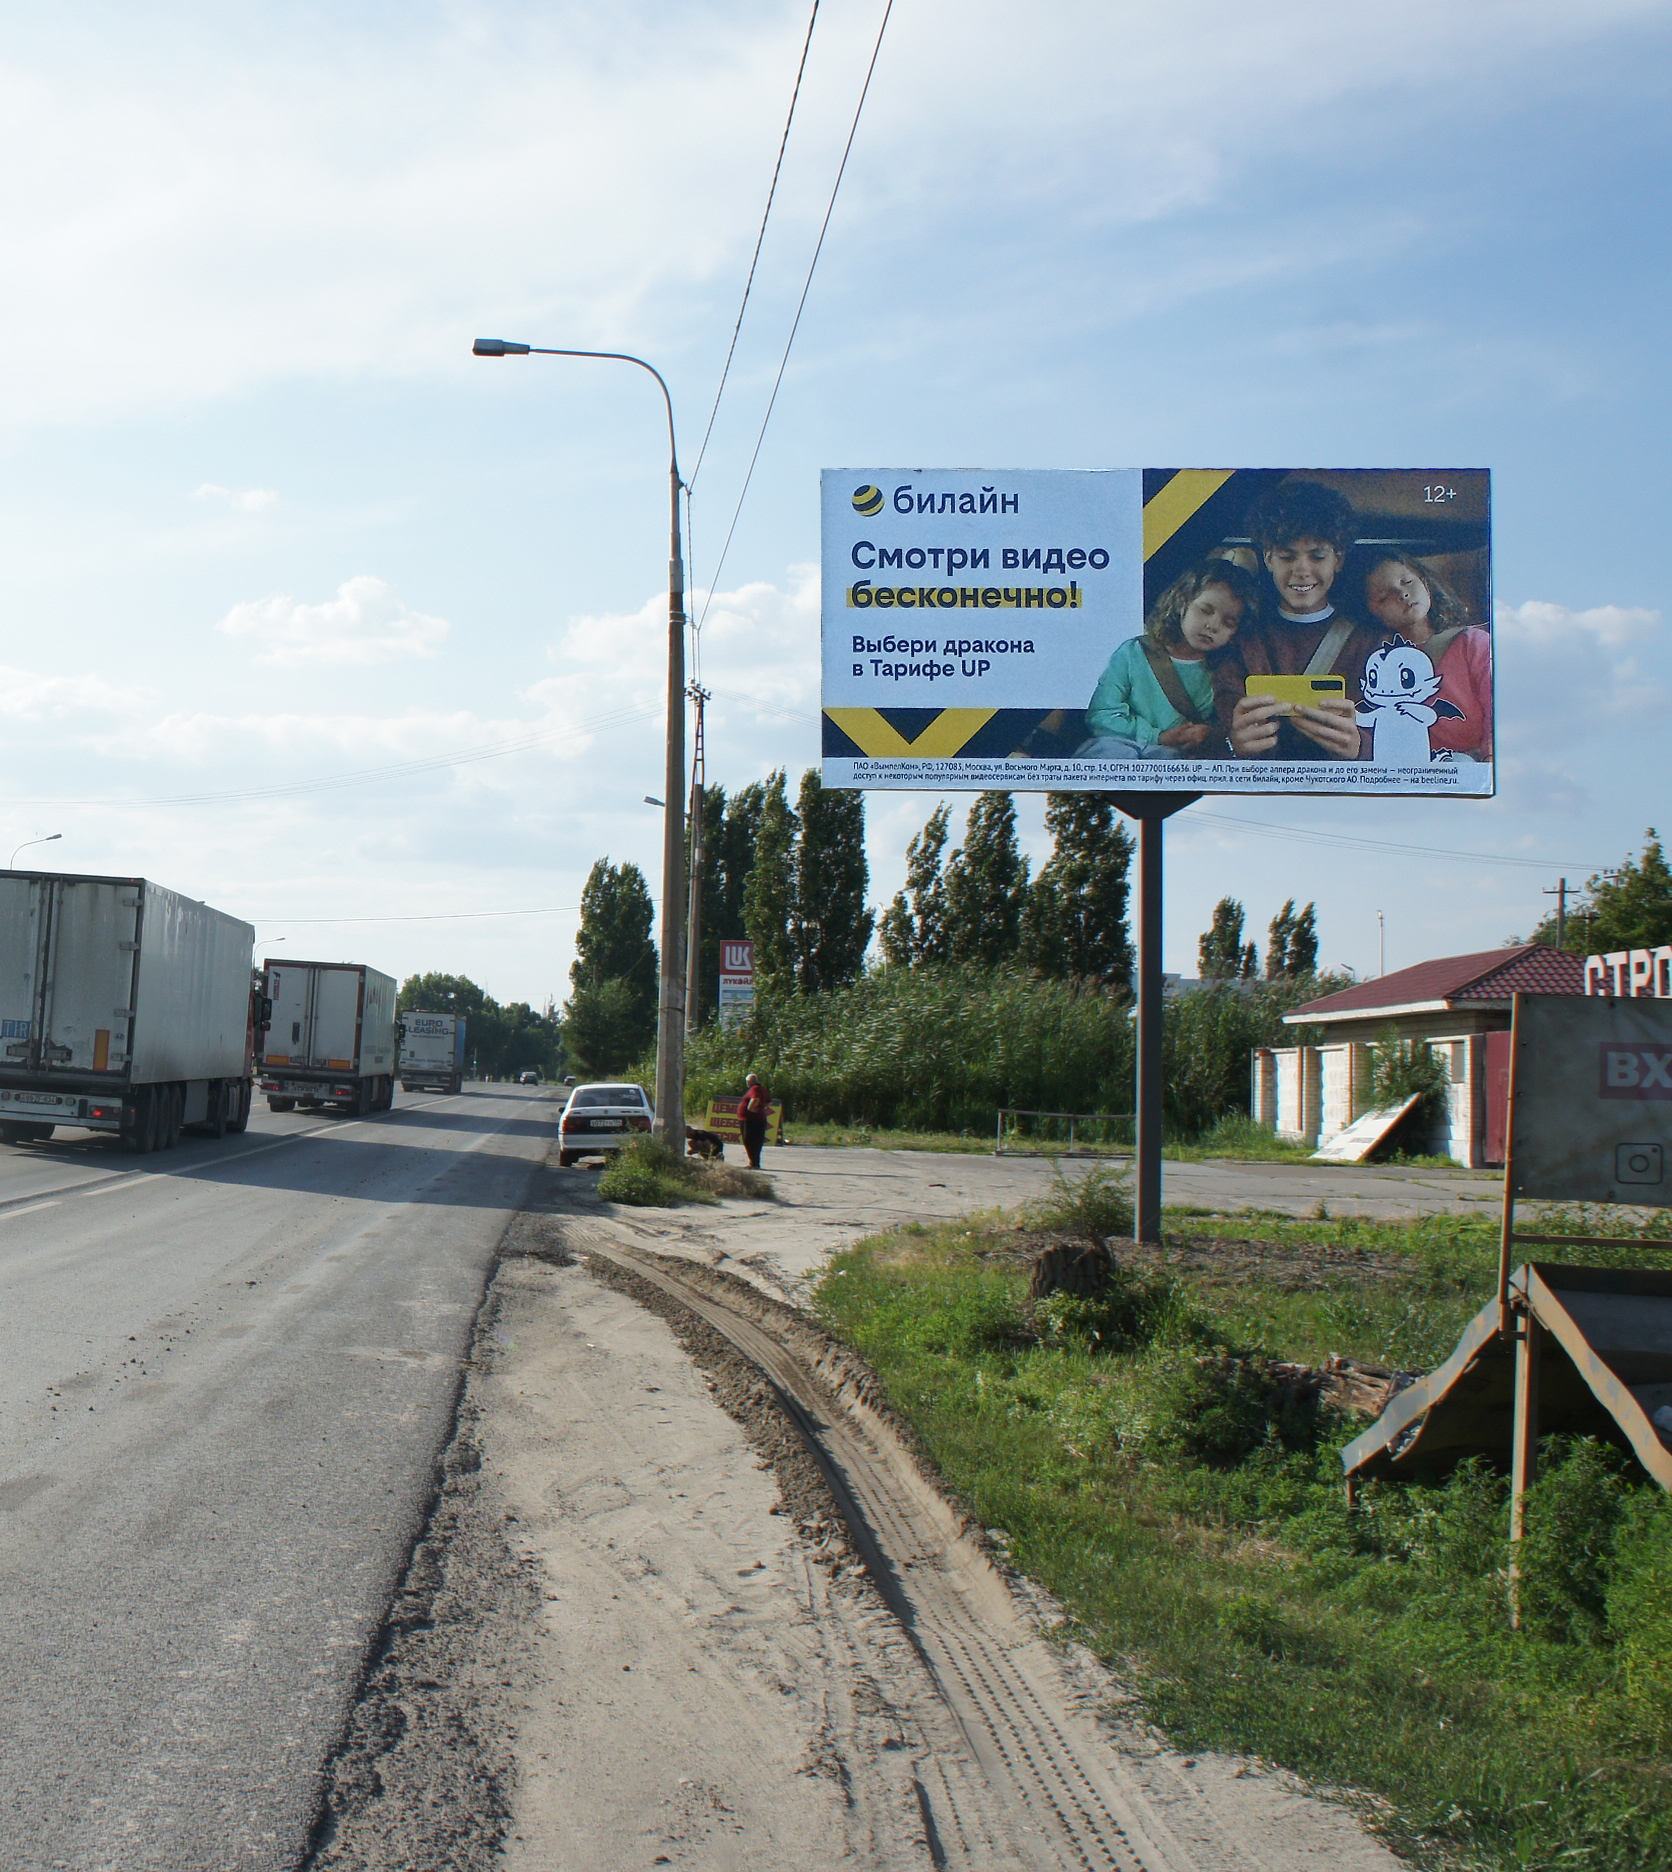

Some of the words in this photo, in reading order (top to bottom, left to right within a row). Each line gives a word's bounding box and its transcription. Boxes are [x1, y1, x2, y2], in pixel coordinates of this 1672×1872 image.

[893, 485, 1019, 515] билайн
[1423, 485, 1457, 503] 12+
[851, 540, 990, 577] Смотри
[1002, 548, 1110, 574] видео
[851, 580, 1078, 609] бесконечно!
[852, 635, 937, 658] Выбери
[943, 638, 1035, 658] дракона
[852, 663, 864, 677] в
[870, 659, 955, 681] Тарифе
[961, 659, 991, 677] UP
[854, 762, 868, 770] ПАО
[964, 762, 994, 773] Москва,
[1004, 763, 1038, 772] Восьмого
[1040, 763, 1064, 774] Марта,
[1110, 763, 1130, 772] ОГРН
[1226, 764, 1240, 775] При
[1242, 764, 1268, 775] выборе
[1296, 767, 1326, 776] дракона
[1398, 765, 1458, 777] неограниченный
[852, 774, 878, 782] доступ
[884, 774, 924, 782] некоторым
[924, 774, 968, 783] популярным
[970, 774, 1026, 783] видеосервисам
[1028, 773, 1040, 781] без
[1042, 775, 1062, 783] траты
[1088, 775, 1126, 784] интернета
[1138, 774, 1164, 784] тарифу
[1164, 776, 1186, 784] через
[1252, 774, 1280, 785] билайн,
[1282, 776, 1304, 785] кроме
[1306, 775, 1346, 785] Чукотского
[1360, 775, 1400, 785] Подробнее
[4, 1020, 27, 1038] TIR
[408, 1026, 449, 1035] LEASING
[414, 1018, 443, 1027] EURO
